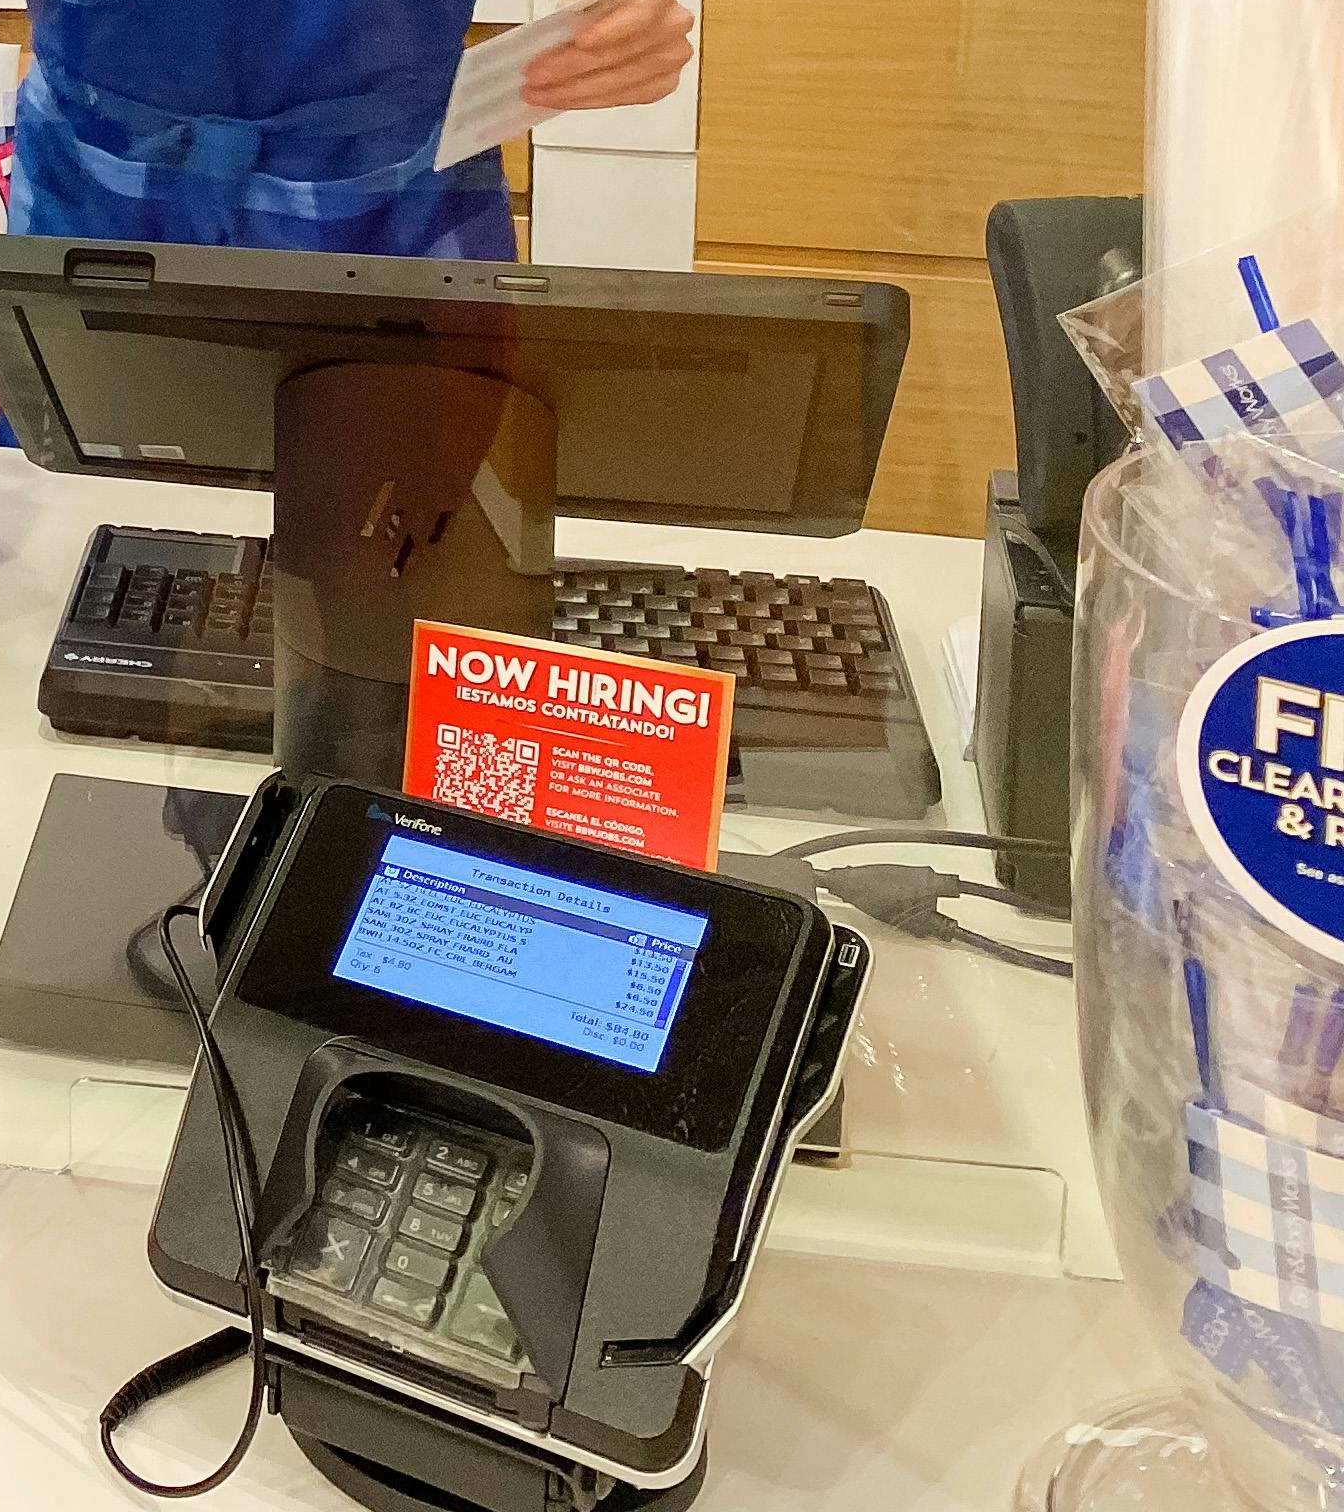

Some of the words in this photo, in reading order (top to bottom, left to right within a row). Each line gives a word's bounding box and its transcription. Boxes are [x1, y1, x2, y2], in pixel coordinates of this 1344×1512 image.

[427, 643, 538, 693] NOW
[547, 665, 710, 728] HIRING!
[552, 747, 579, 759] SCAN
[582, 752, 602, 764] THE
[604, 757, 619, 768] QR
[552, 759, 577, 770] VISIT
[548, 782, 570, 794] FOR
[572, 788, 602, 801] MORE
[550, 771, 565, 780] OR
[567, 775, 586, 785] ASK
[589, 779, 604, 788] AN
[606, 782, 661, 801] ASSOCIATE
[1276, 802, 1314, 840] &
[403, 870, 466, 894] Description
[472, 869, 550, 898] Transaction
[558, 892, 611, 913] Details
[651, 939, 682, 954] Price
[382, 956, 411, 971] $4.80
[607, 1022, 649, 1041] $84.80
[612, 1037, 645, 1052] $0.00
[436, 1147, 449, 1160] 2
[397, 1256, 408, 1268] 0
